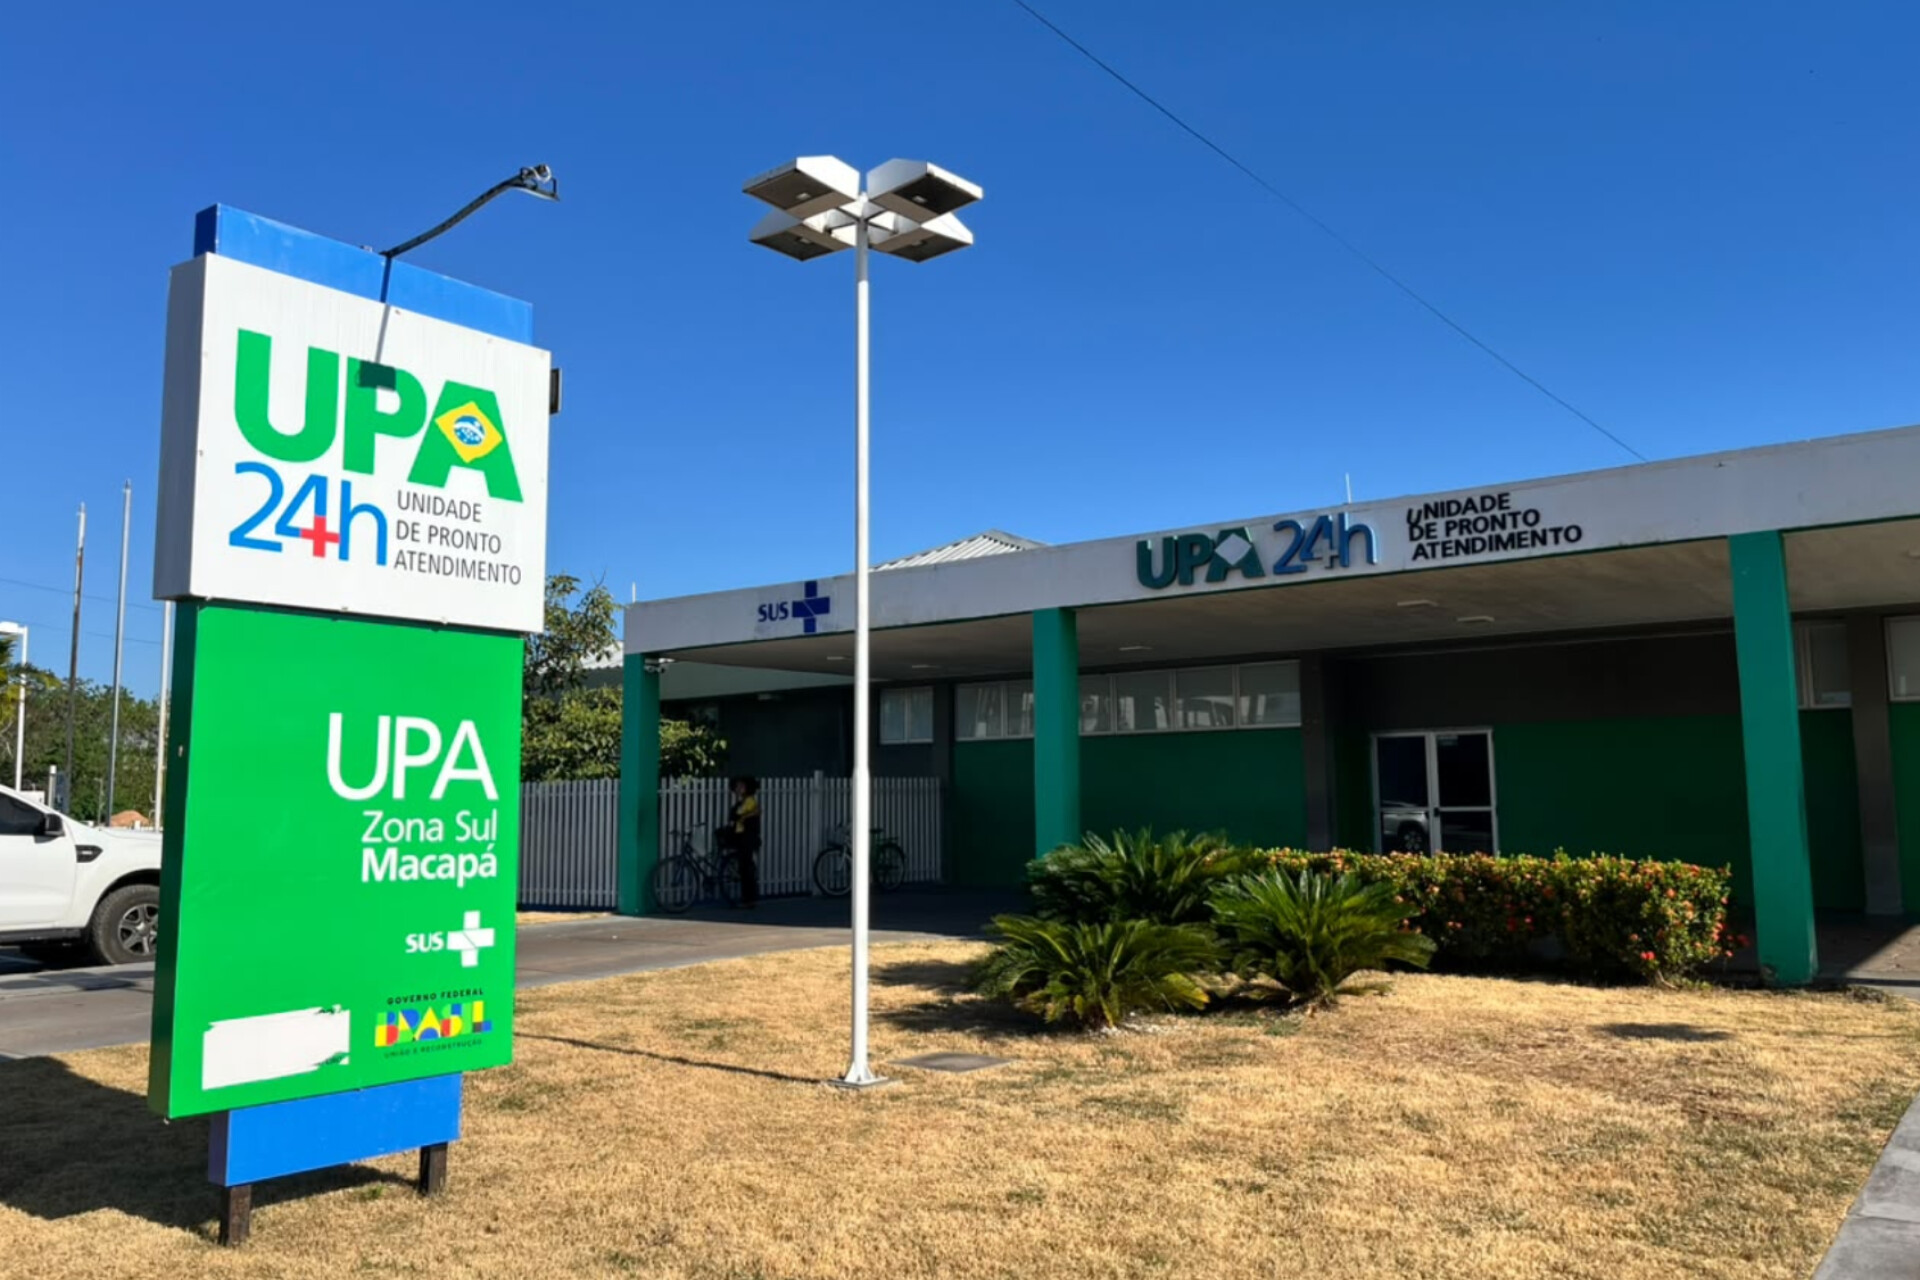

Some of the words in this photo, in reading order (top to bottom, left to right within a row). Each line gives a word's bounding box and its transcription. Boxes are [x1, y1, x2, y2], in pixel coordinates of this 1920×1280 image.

[234, 328, 524, 503] UPA
[229, 461, 388, 566] 24h
[397, 489, 482, 523] UNIDADE
[1406, 493, 1512, 526] UNIDADE
[396, 519, 421, 543] DE
[428, 524, 501, 555] PRONTO
[1409, 521, 1439, 542] DE
[1444, 508, 1541, 537] PRONTO
[1136, 527, 1265, 590] UPA
[1273, 511, 1379, 575] 24h
[1412, 525, 1583, 562] ATENDIMENTO
[393, 549, 522, 586] ATENDIMENTO
[758, 601, 788, 622] SUS
[327, 712, 499, 801] UPA
[361, 810, 444, 843] Zona
[455, 808, 497, 842] Sul
[361, 843, 498, 888] Macapá
[405, 931, 445, 953] SUS
[386, 992, 437, 1005] GOVERNO
[441, 988, 484, 999] FEDERAL
[374, 1000, 494, 1048] BRASIL
